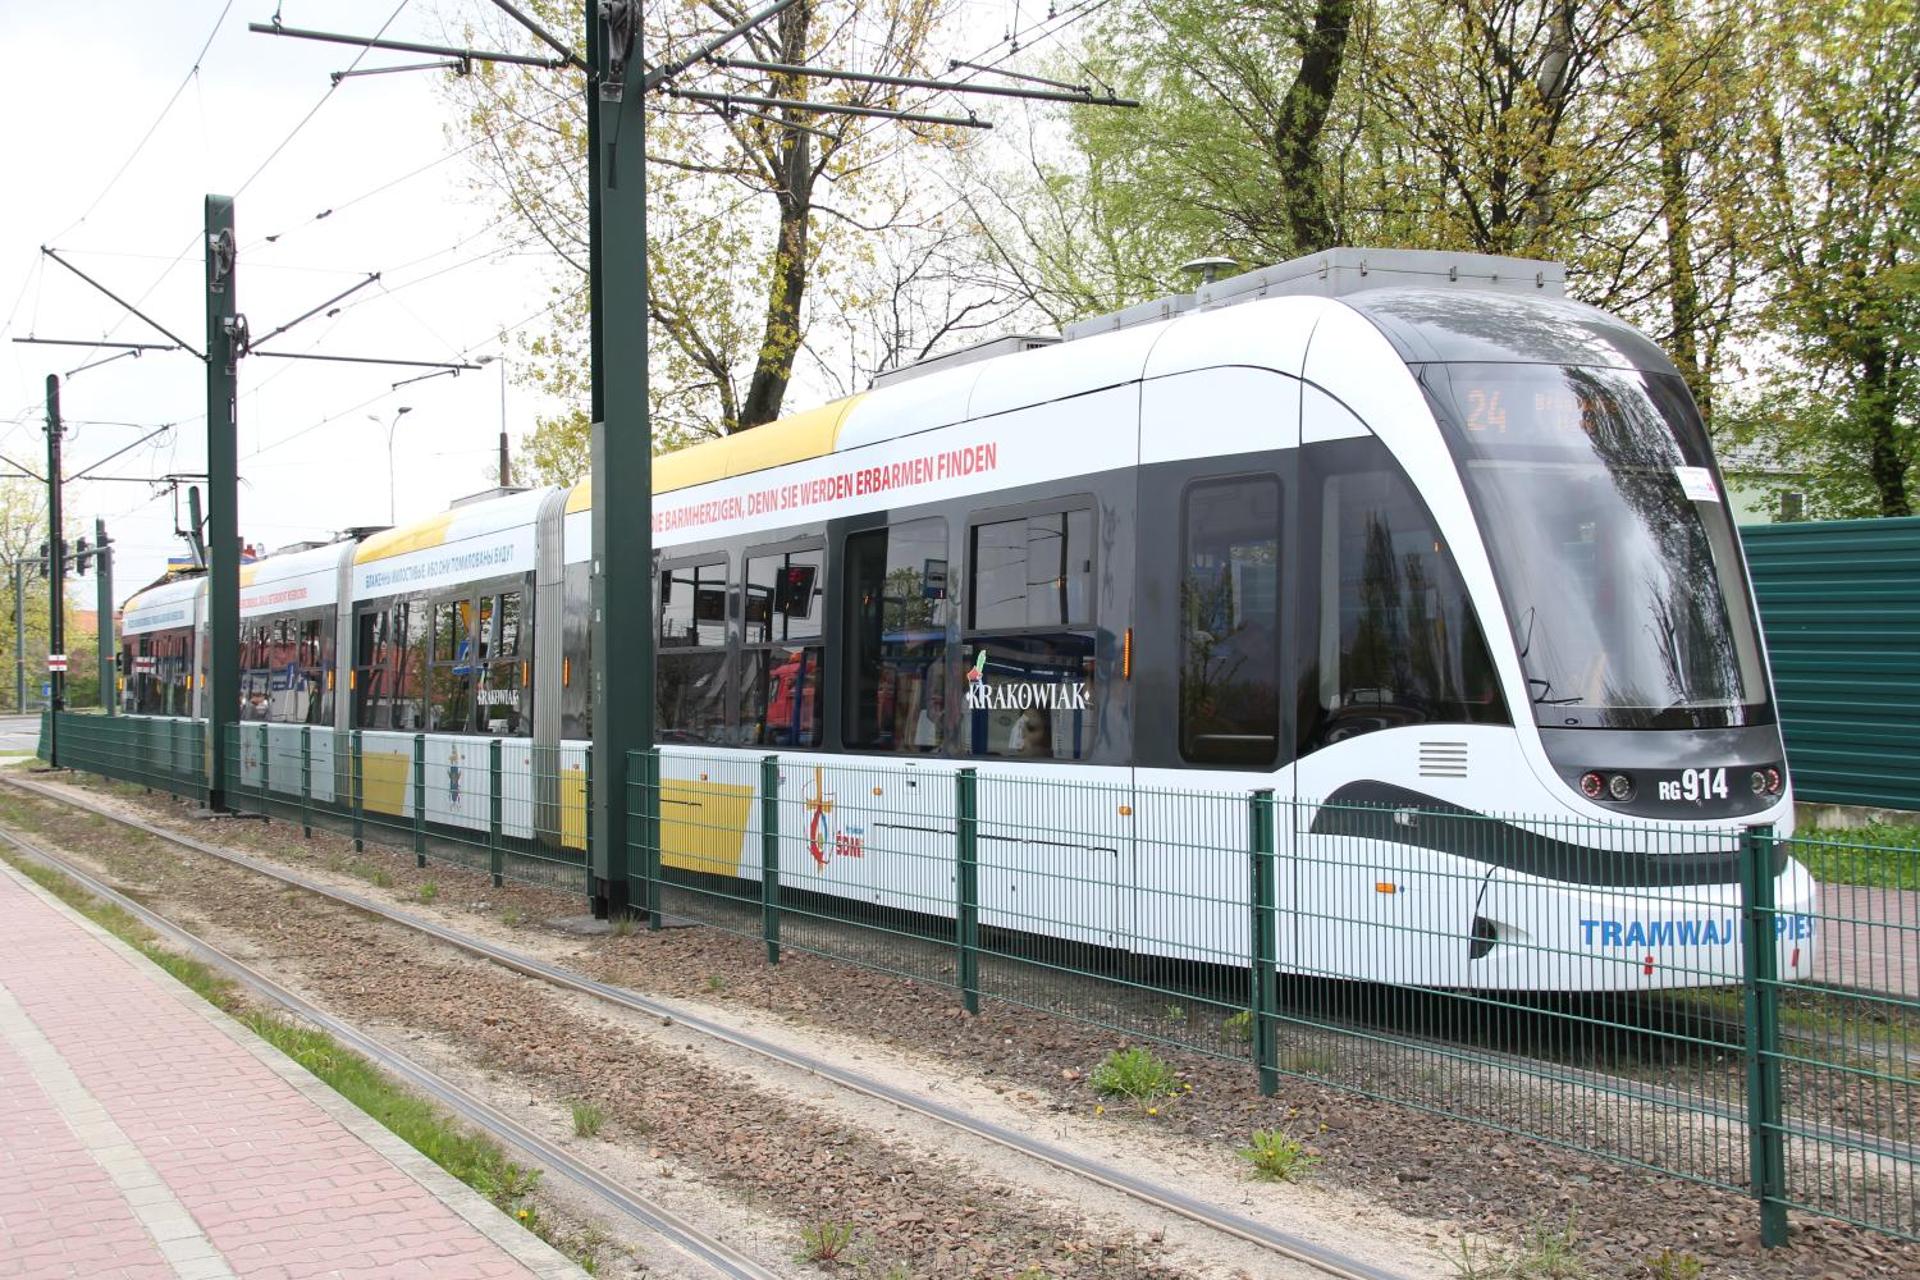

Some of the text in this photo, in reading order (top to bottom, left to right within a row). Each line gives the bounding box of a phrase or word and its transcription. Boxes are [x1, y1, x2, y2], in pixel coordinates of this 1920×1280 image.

[1468, 388, 1507, 433] 24
[748, 488, 778, 516] DENN
[781, 485, 798, 510] SIE
[801, 473, 853, 506] WERDEN
[856, 456, 933, 496] ERBARMEN
[937, 442, 997, 480] FINDEN
[968, 683, 1086, 710] KRAKOWIAK
[1580, 919, 1733, 946] TRAMWAJ
